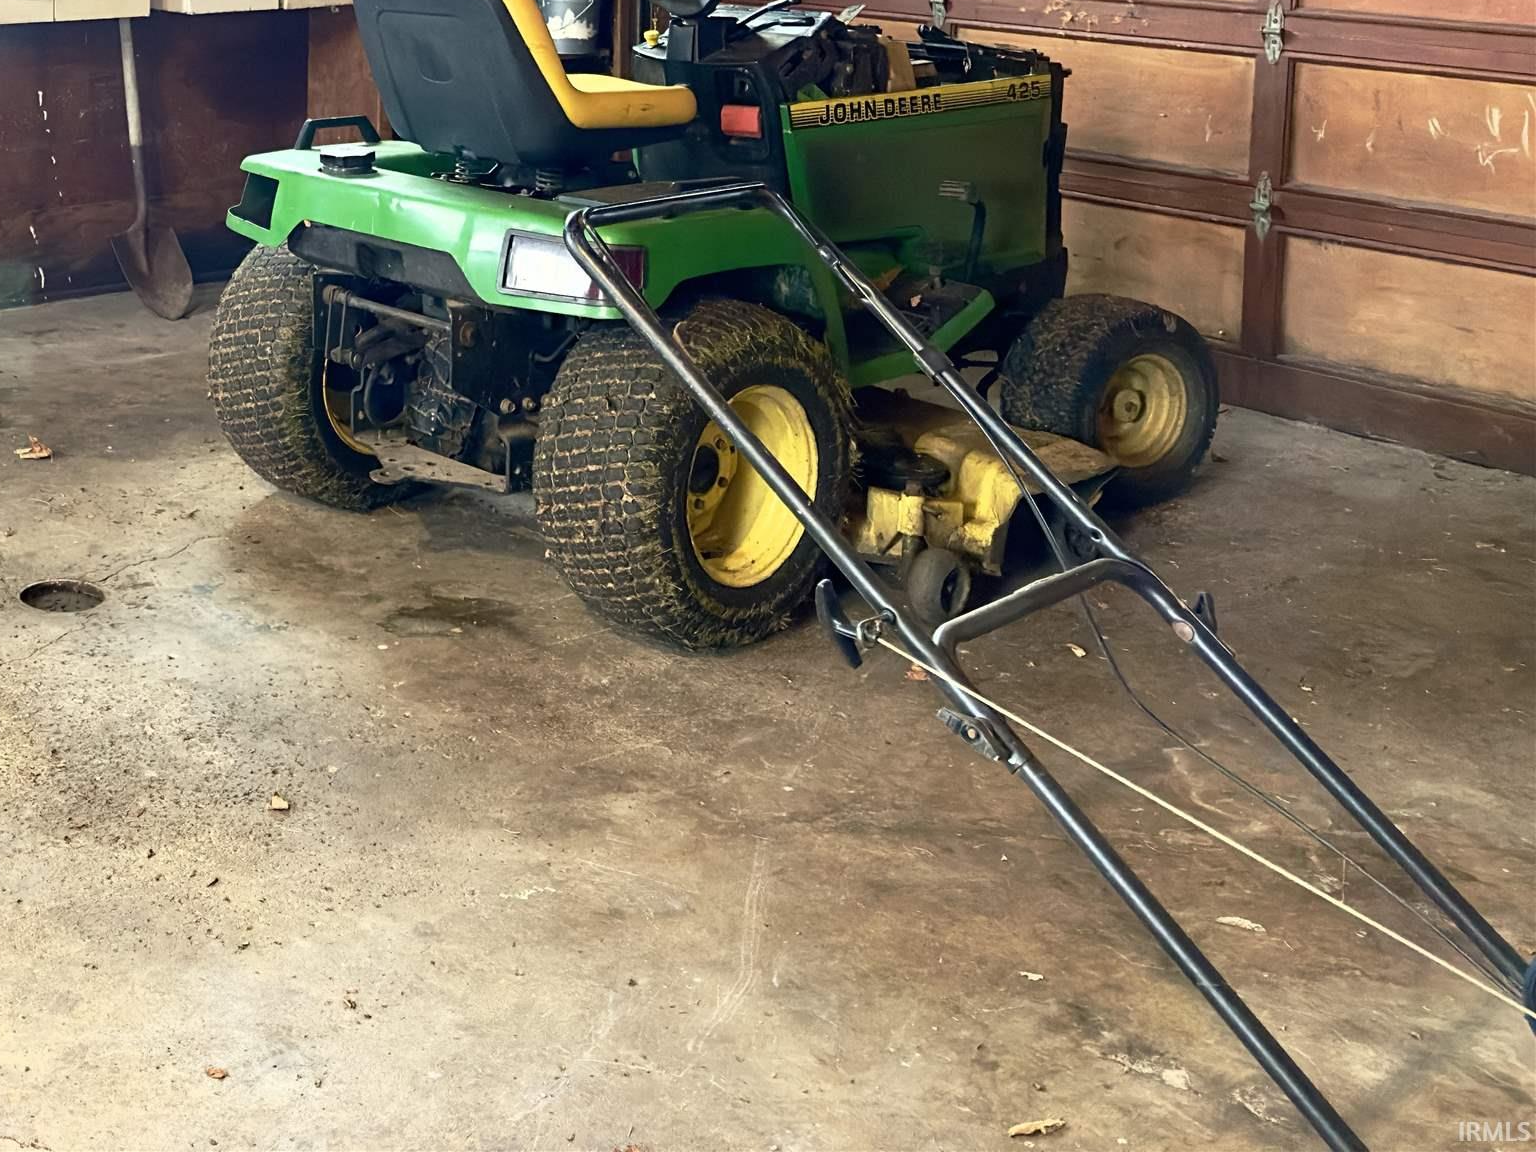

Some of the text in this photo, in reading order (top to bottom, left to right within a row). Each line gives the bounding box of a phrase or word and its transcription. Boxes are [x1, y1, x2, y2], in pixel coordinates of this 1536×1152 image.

[1006, 80, 1041, 100] 425
[818, 93, 943, 125] JOHN DEERE
